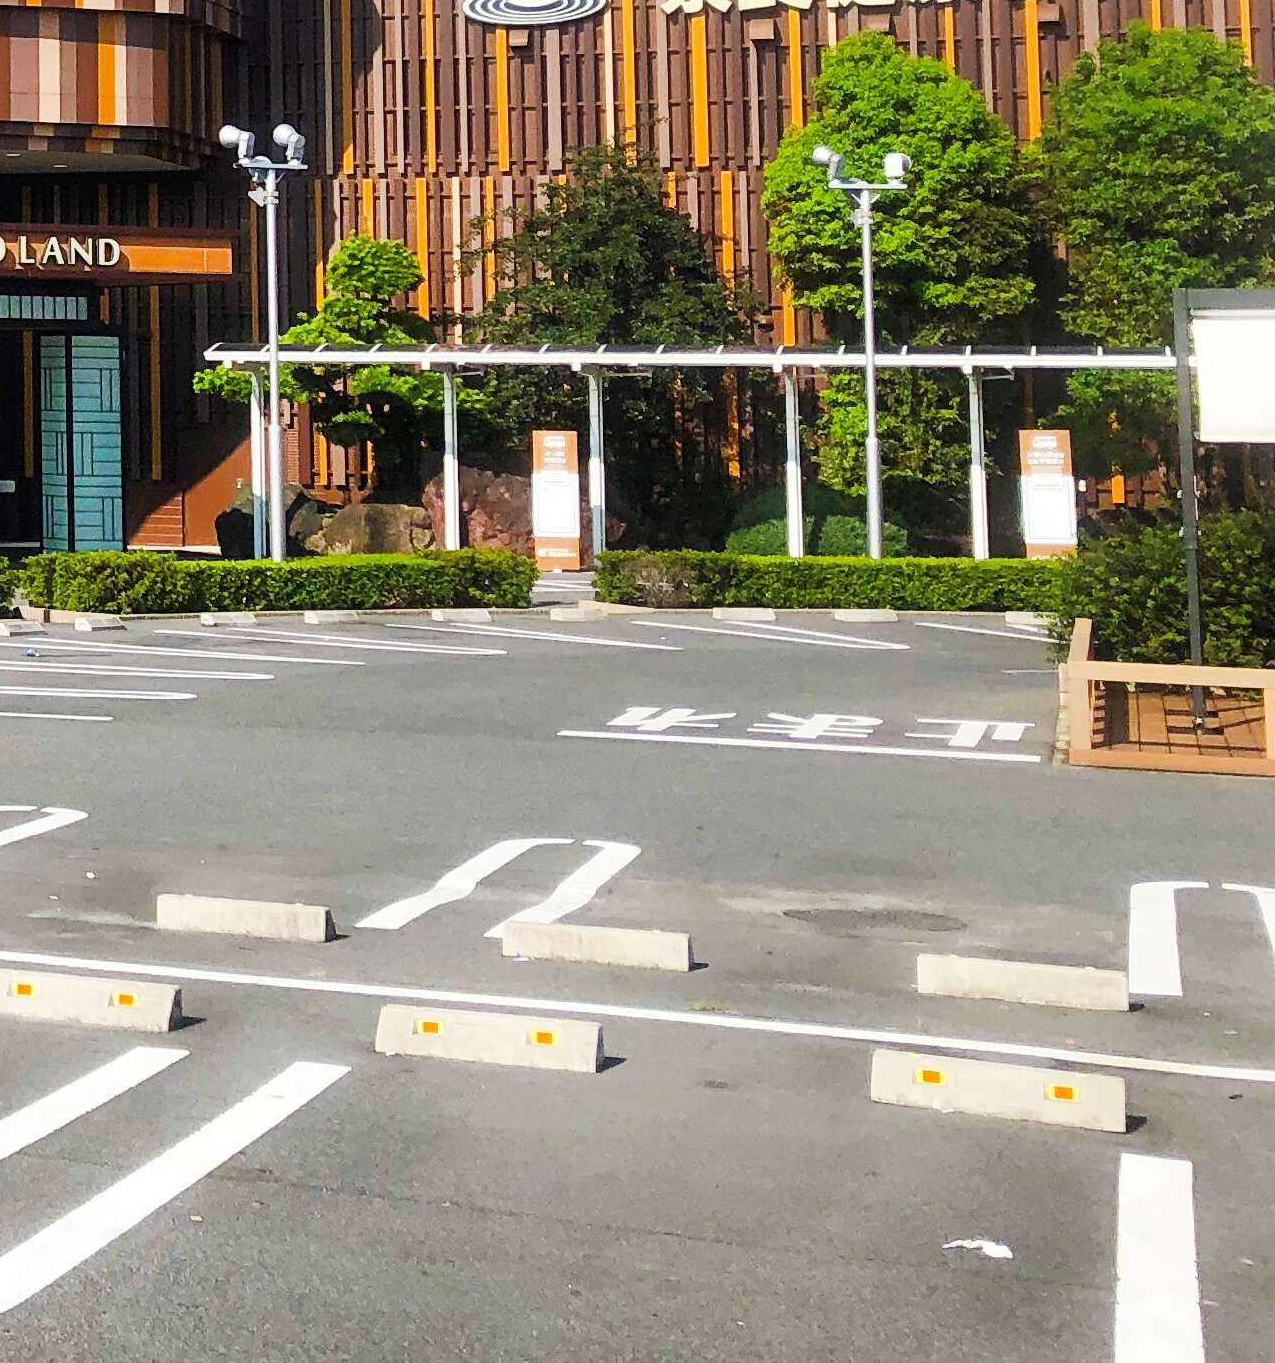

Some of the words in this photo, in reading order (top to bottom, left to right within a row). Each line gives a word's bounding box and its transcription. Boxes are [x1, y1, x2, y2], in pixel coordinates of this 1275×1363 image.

[17, 235, 121, 267] LAND
[606, 706, 1036, 748] 止まれ
